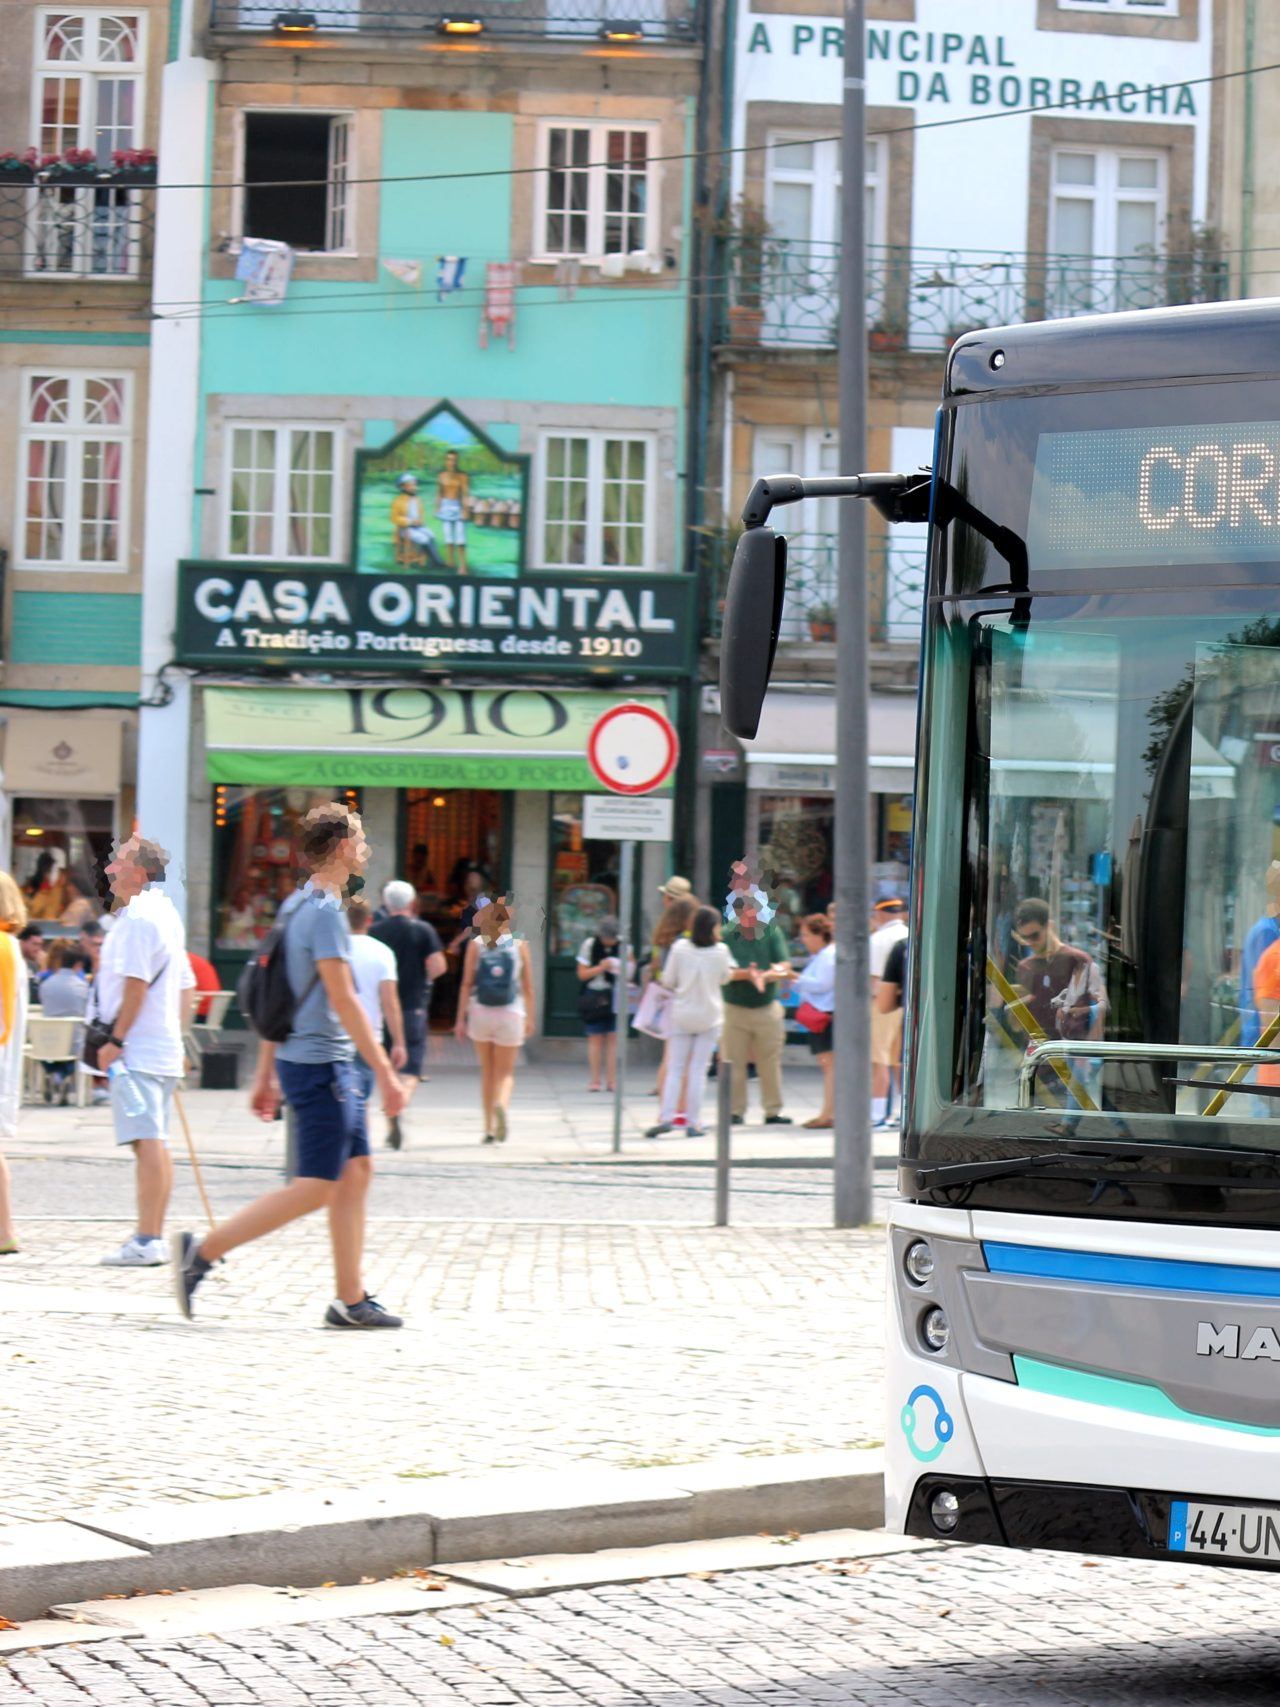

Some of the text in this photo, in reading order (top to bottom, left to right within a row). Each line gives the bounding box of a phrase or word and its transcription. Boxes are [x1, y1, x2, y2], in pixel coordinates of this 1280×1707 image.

[747, 22, 1015, 67] A PRNCIPAL
[898, 70, 1196, 116] DA BORRACHA
[194, 577, 676, 633] CASA ORIENTAL
[215, 627, 643, 658] A Tradição Portuguesa desde 1910
[338, 688, 569, 743] 1910
[330, 762, 465, 781] CONSERVEIRA
[518, 767, 587, 784] PORTO
[1174, 1531, 1182, 1541] P
